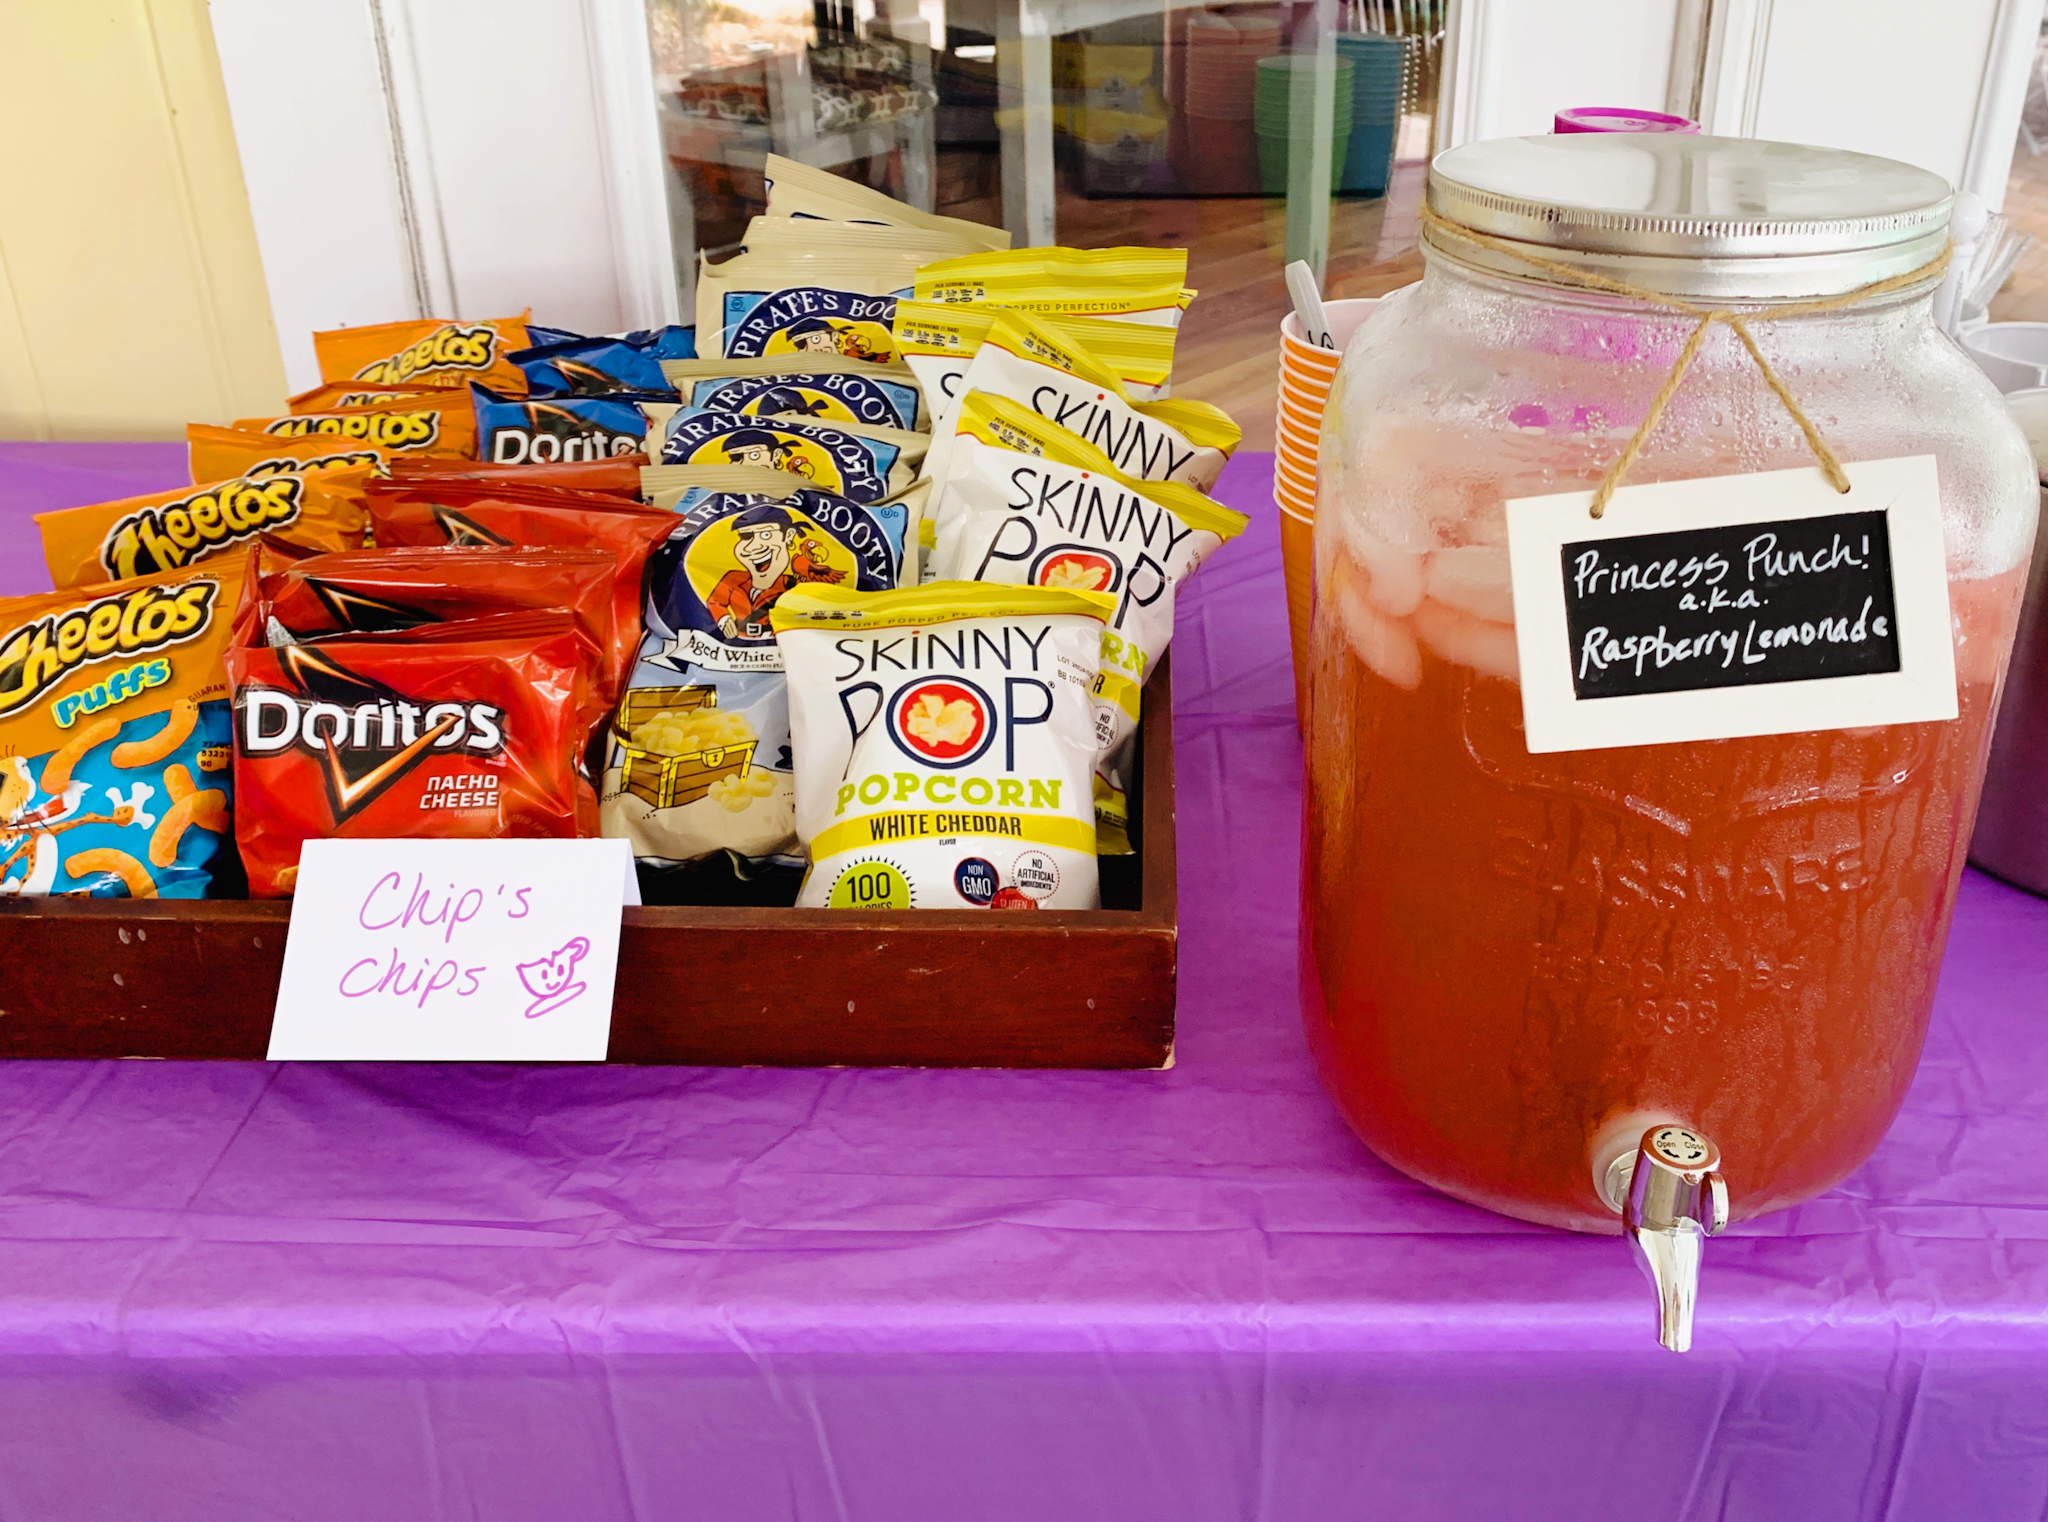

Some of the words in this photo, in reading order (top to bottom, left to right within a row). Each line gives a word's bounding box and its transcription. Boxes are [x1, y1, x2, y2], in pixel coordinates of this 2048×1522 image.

[731, 289, 840, 358] PIRATE'S
[1032, 385, 1195, 481] SKINNY
[103, 478, 300, 580] Cheetos
[1008, 467, 1193, 563] SKINNY
[811, 497, 888, 583] BOOTY
[974, 516, 1166, 630] POP
[1573, 549, 1730, 600] Princess
[1742, 532, 1870, 583] Punch!
[1678, 586, 1769, 614] a.k.a.
[688, 634, 721, 661] Aged
[723, 648, 774, 663] White
[834, 624, 1052, 683] SKINNY
[1578, 625, 1740, 680] Raspberry
[187, 683, 227, 703] GUARAN
[245, 689, 502, 751] Doritos
[838, 675, 1056, 782] POP
[426, 774, 499, 792] NACHO
[834, 772, 1063, 817] POPCORN
[419, 791, 500, 810] CHEESE
[870, 813, 929, 842] WHITE
[935, 813, 1023, 837] CHEDDAR
[938, 838, 957, 847] FLAVOR
[966, 864, 984, 876] NON
[1016, 867, 1056, 884] ARTIFICIAL
[1031, 858, 1043, 870] NO
[846, 871, 891, 903] 100
[961, 876, 992, 897] GMO
[359, 871, 533, 944] Chip's
[998, 897, 1028, 909] GLUTEN
[1655, 1140, 1677, 1149] Open
[1684, 1140, 1706, 1151] Close
